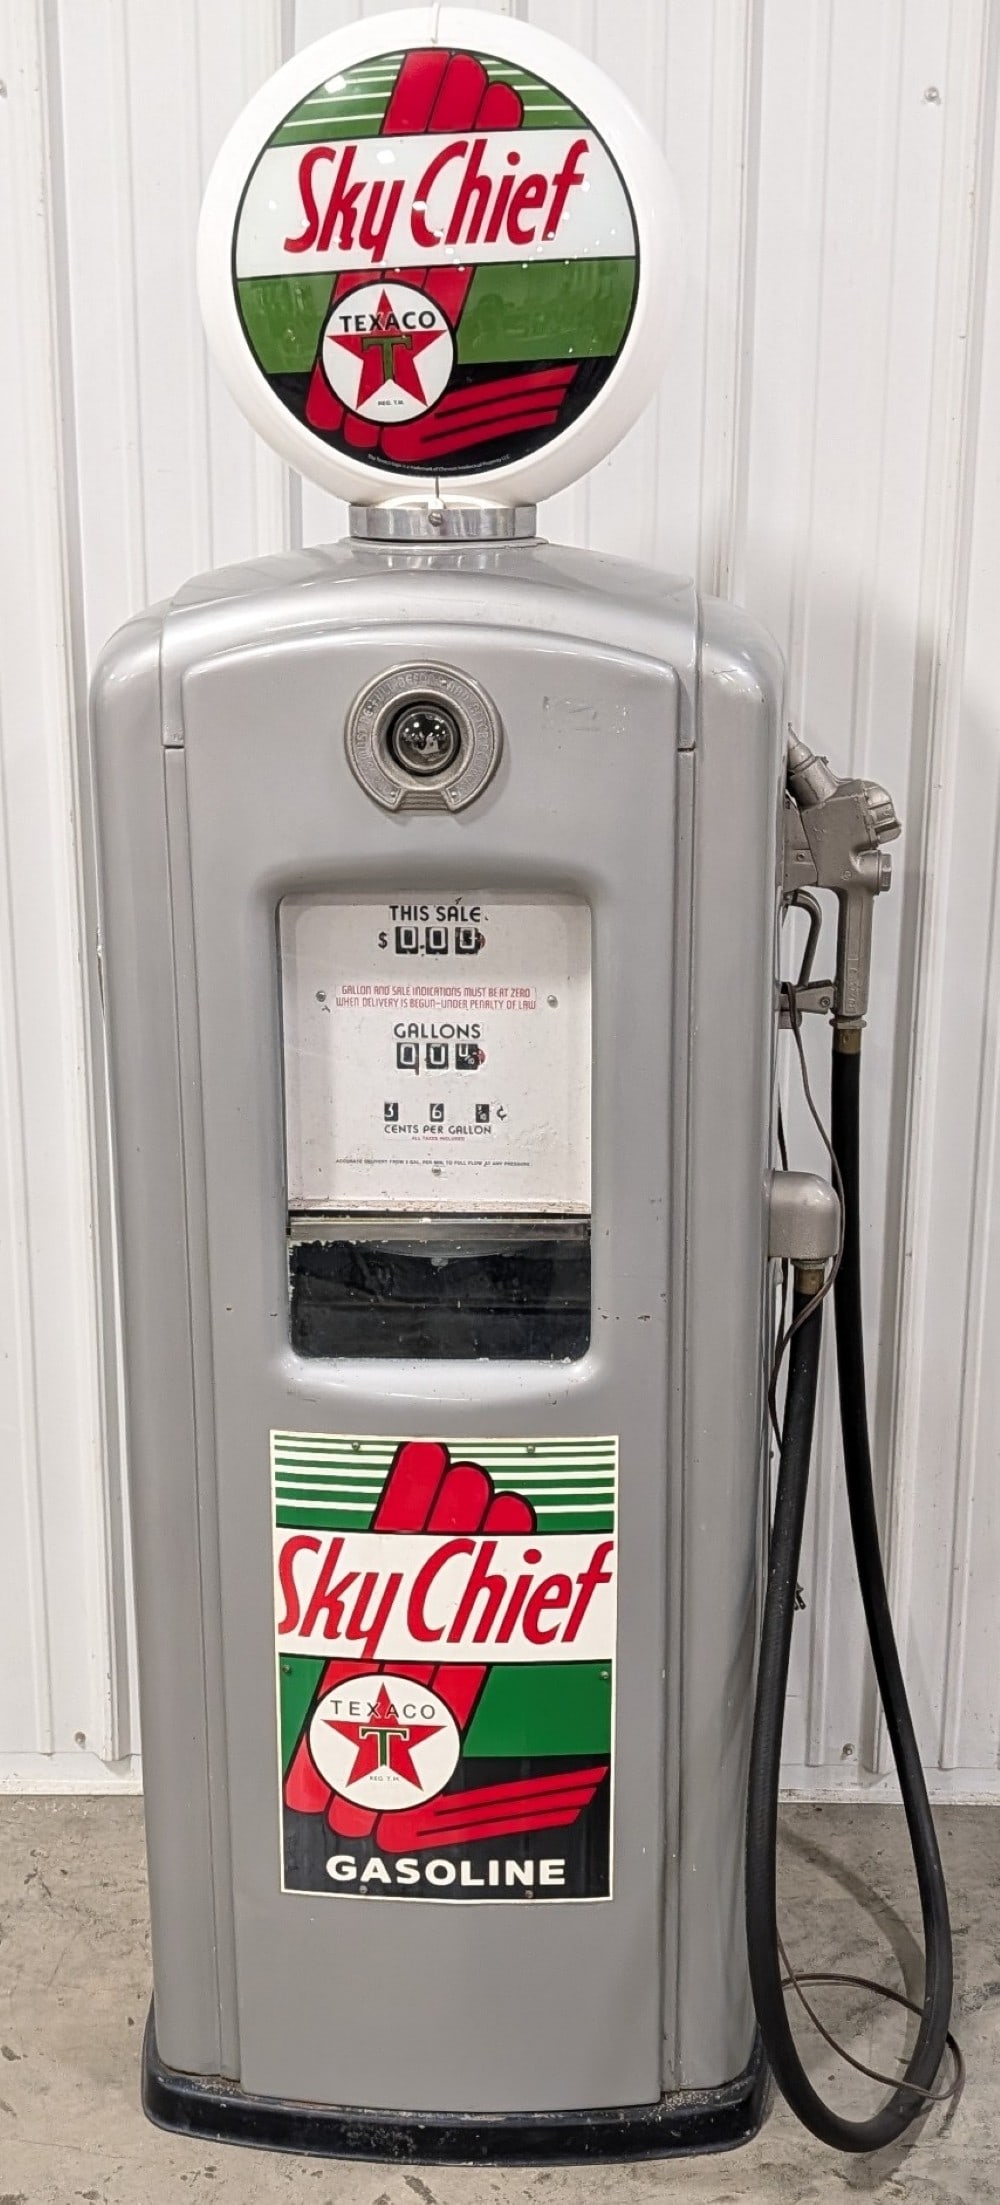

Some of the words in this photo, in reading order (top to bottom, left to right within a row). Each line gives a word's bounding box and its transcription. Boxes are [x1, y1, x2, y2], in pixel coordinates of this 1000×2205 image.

[283, 145, 405, 263] Sky
[411, 139, 589, 247] Chief
[339, 311, 436, 332] TEXACO
[362, 336, 412, 384] T
[389, 905, 429, 922] THIS
[436, 906, 481, 923] SALE
[342, 985, 371, 995] GALLON
[374, 986, 390, 996] AND
[392, 986, 411, 996] SALE
[412, 986, 461, 997] INDICATIONS
[464, 987, 486, 997] MUST
[488, 988, 497, 998] BE
[499, 988, 508, 998] AT
[511, 988, 530, 998] ZERO
[336, 997, 359, 1007] WHEN
[363, 997, 399, 1008] DELIVERY
[401, 998, 408, 1008] IS
[470, 1000, 504, 1010] PENALTY
[507, 1000, 515, 1010] OF
[519, 1000, 536, 1010] LAW
[394, 1023, 481, 1039] GALLONS
[384, 1124, 419, 1134] CENTS
[423, 1125, 444, 1134] PER
[448, 1125, 491, 1135] GALLON
[278, 1535, 403, 1659] Sky
[407, 1538, 614, 1645] Chief
[330, 1700, 436, 1720] TEXACO
[359, 1726, 409, 1768] T
[326, 1855, 566, 1886] GASOLINE
